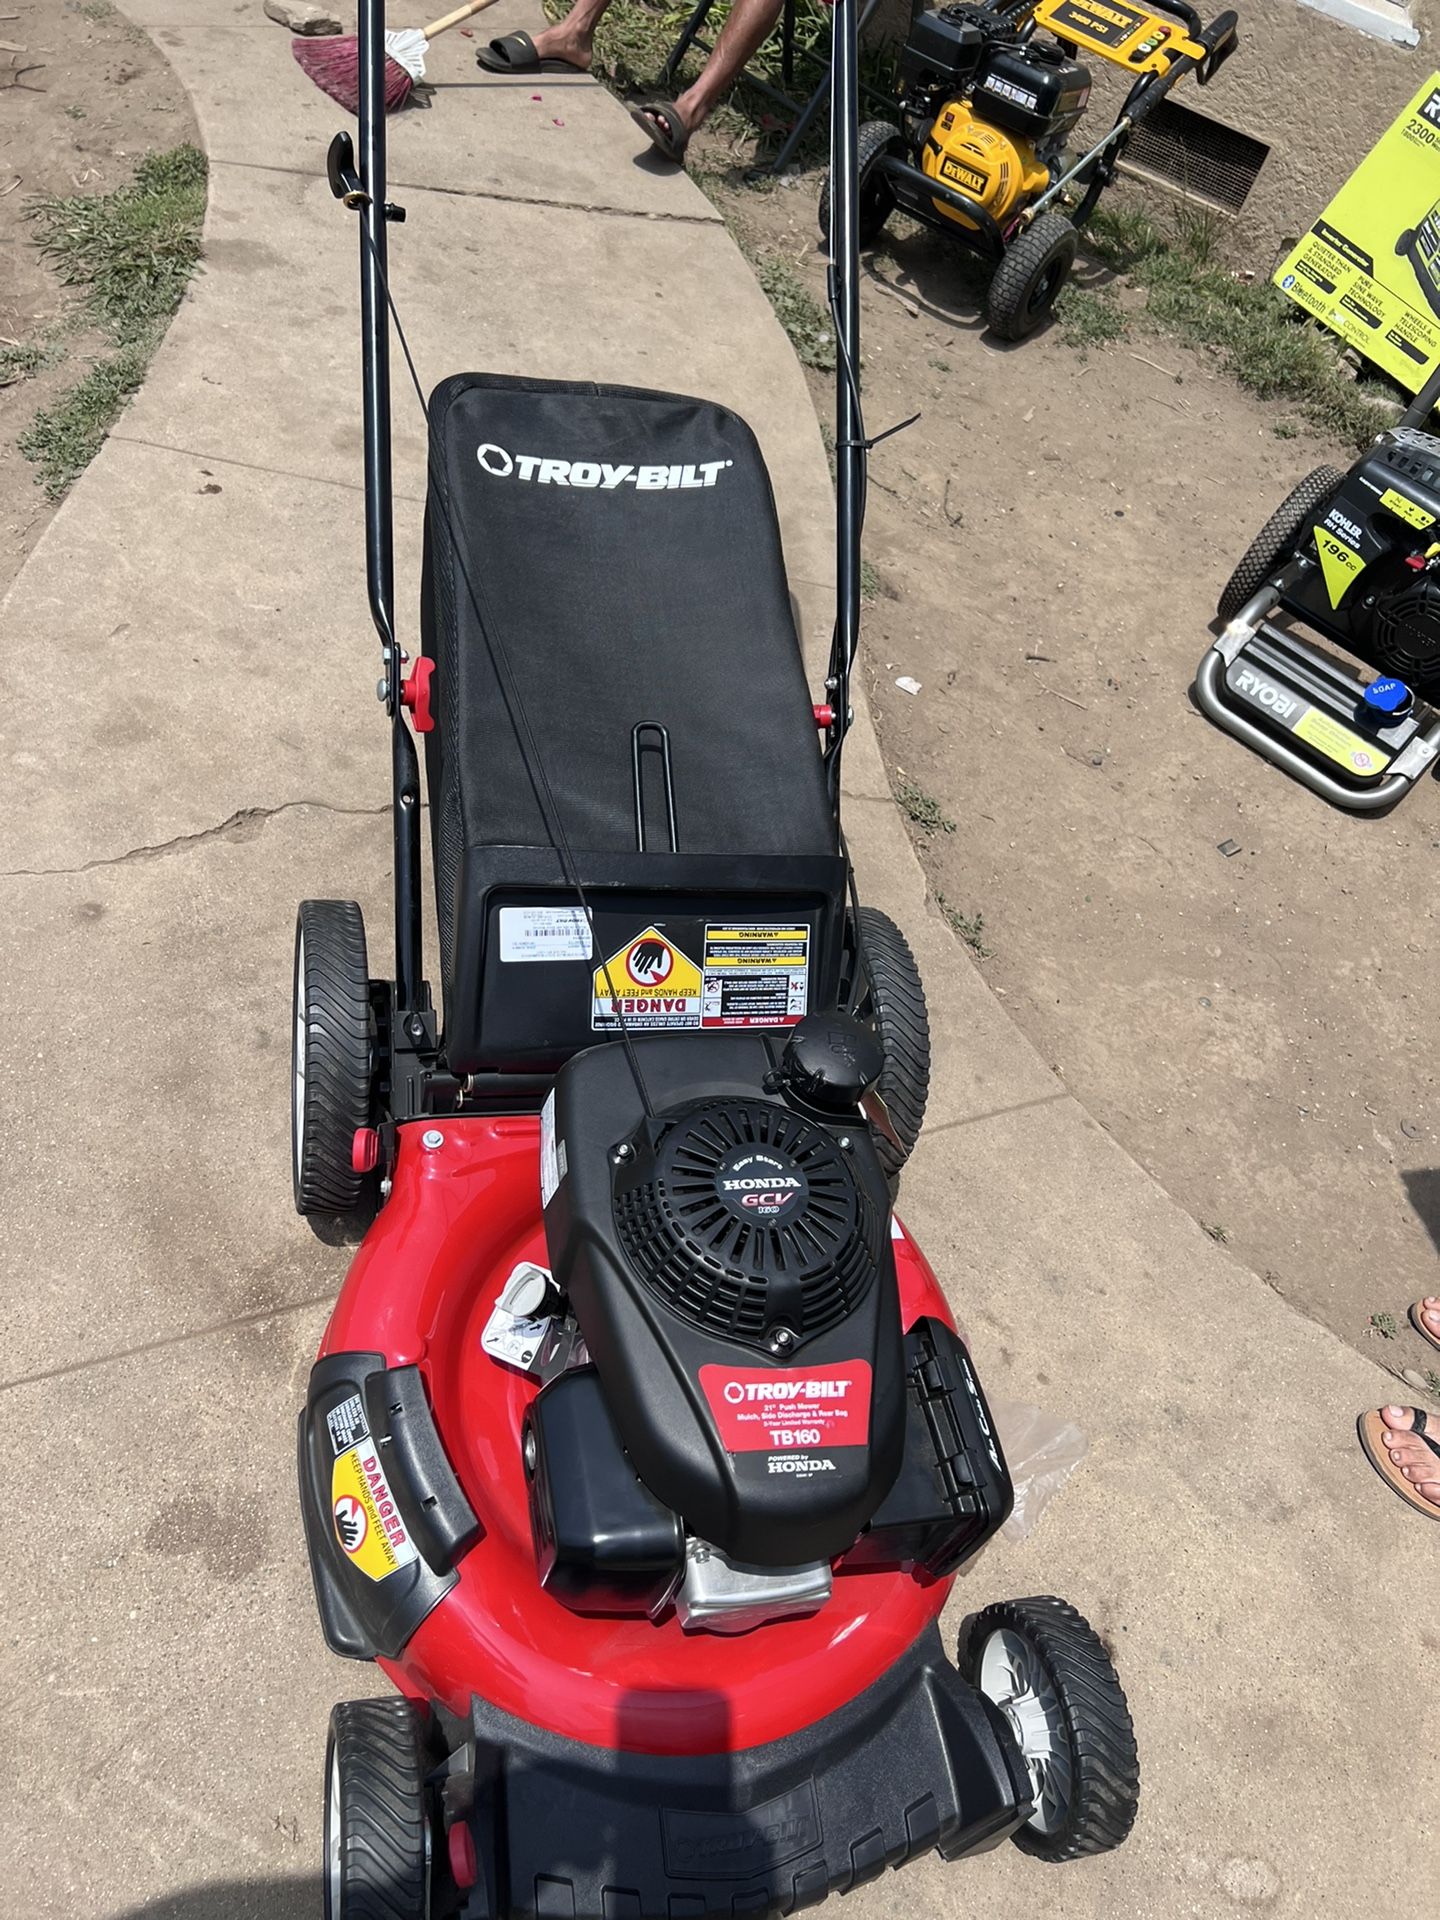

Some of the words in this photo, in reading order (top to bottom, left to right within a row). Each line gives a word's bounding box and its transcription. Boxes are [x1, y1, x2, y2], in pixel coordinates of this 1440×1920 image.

[1090, 21, 1109, 34] PSI
[1406, 118, 1436, 144] 2300
[944, 159, 985, 191] DEWALT
[1312, 241, 1337, 263] QUIETER
[1335, 256, 1352, 273] THAN
[1313, 250, 1342, 276] STANDARD
[1358, 275, 1373, 289] PURE
[1348, 287, 1386, 318] TECHNOLOGY
[1353, 281, 1368, 295] SINE
[1366, 292, 1384, 307] WAVE
[1404, 311, 1427, 330] WHEELS
[1394, 323, 1418, 343] HANDLE
[1400, 317, 1437, 347] TELESCOPING
[515, 454, 726, 490] TROY-BILT
[1329, 508, 1362, 540] KOHLER
[1323, 518, 1338, 530] RH
[1335, 527, 1361, 549] Series
[1322, 539, 1350, 562] 196
[1235, 669, 1298, 719] RYOBI
[1372, 682, 1397, 695] SOAP
[622, 988, 640, 997] FEET
[640, 988, 653, 997] and
[654, 988, 678, 997] HANDS
[679, 988, 697, 997] KEEP
[611, 998, 686, 1013] DANGER
[749, 1016, 778, 1024] DANGER
[732, 1156, 753, 1172] Easy
[755, 1154, 783, 1170] Start
[722, 1177, 802, 1191] HONDA
[741, 1192, 794, 1207] GCV
[758, 1205, 780, 1214] 160
[745, 1380, 848, 1400] TROY-BILT
[737, 1413, 760, 1421] Mulch,
[761, 1412, 776, 1420] Side
[777, 1411, 811, 1420] Discharge
[834, 1409, 848, 1418] Bag
[779, 1403, 797, 1411] Push
[770, 1428, 821, 1446] TB160
[768, 1459, 836, 1473] HONDA
[350, 1453, 363, 1475] KEEP
[357, 1474, 372, 1504] HANDS
[366, 1503, 378, 1520] and
[373, 1519, 388, 1541] FEET
[381, 1540, 397, 1566] AWAY
[363, 1455, 407, 1548] DANGER
